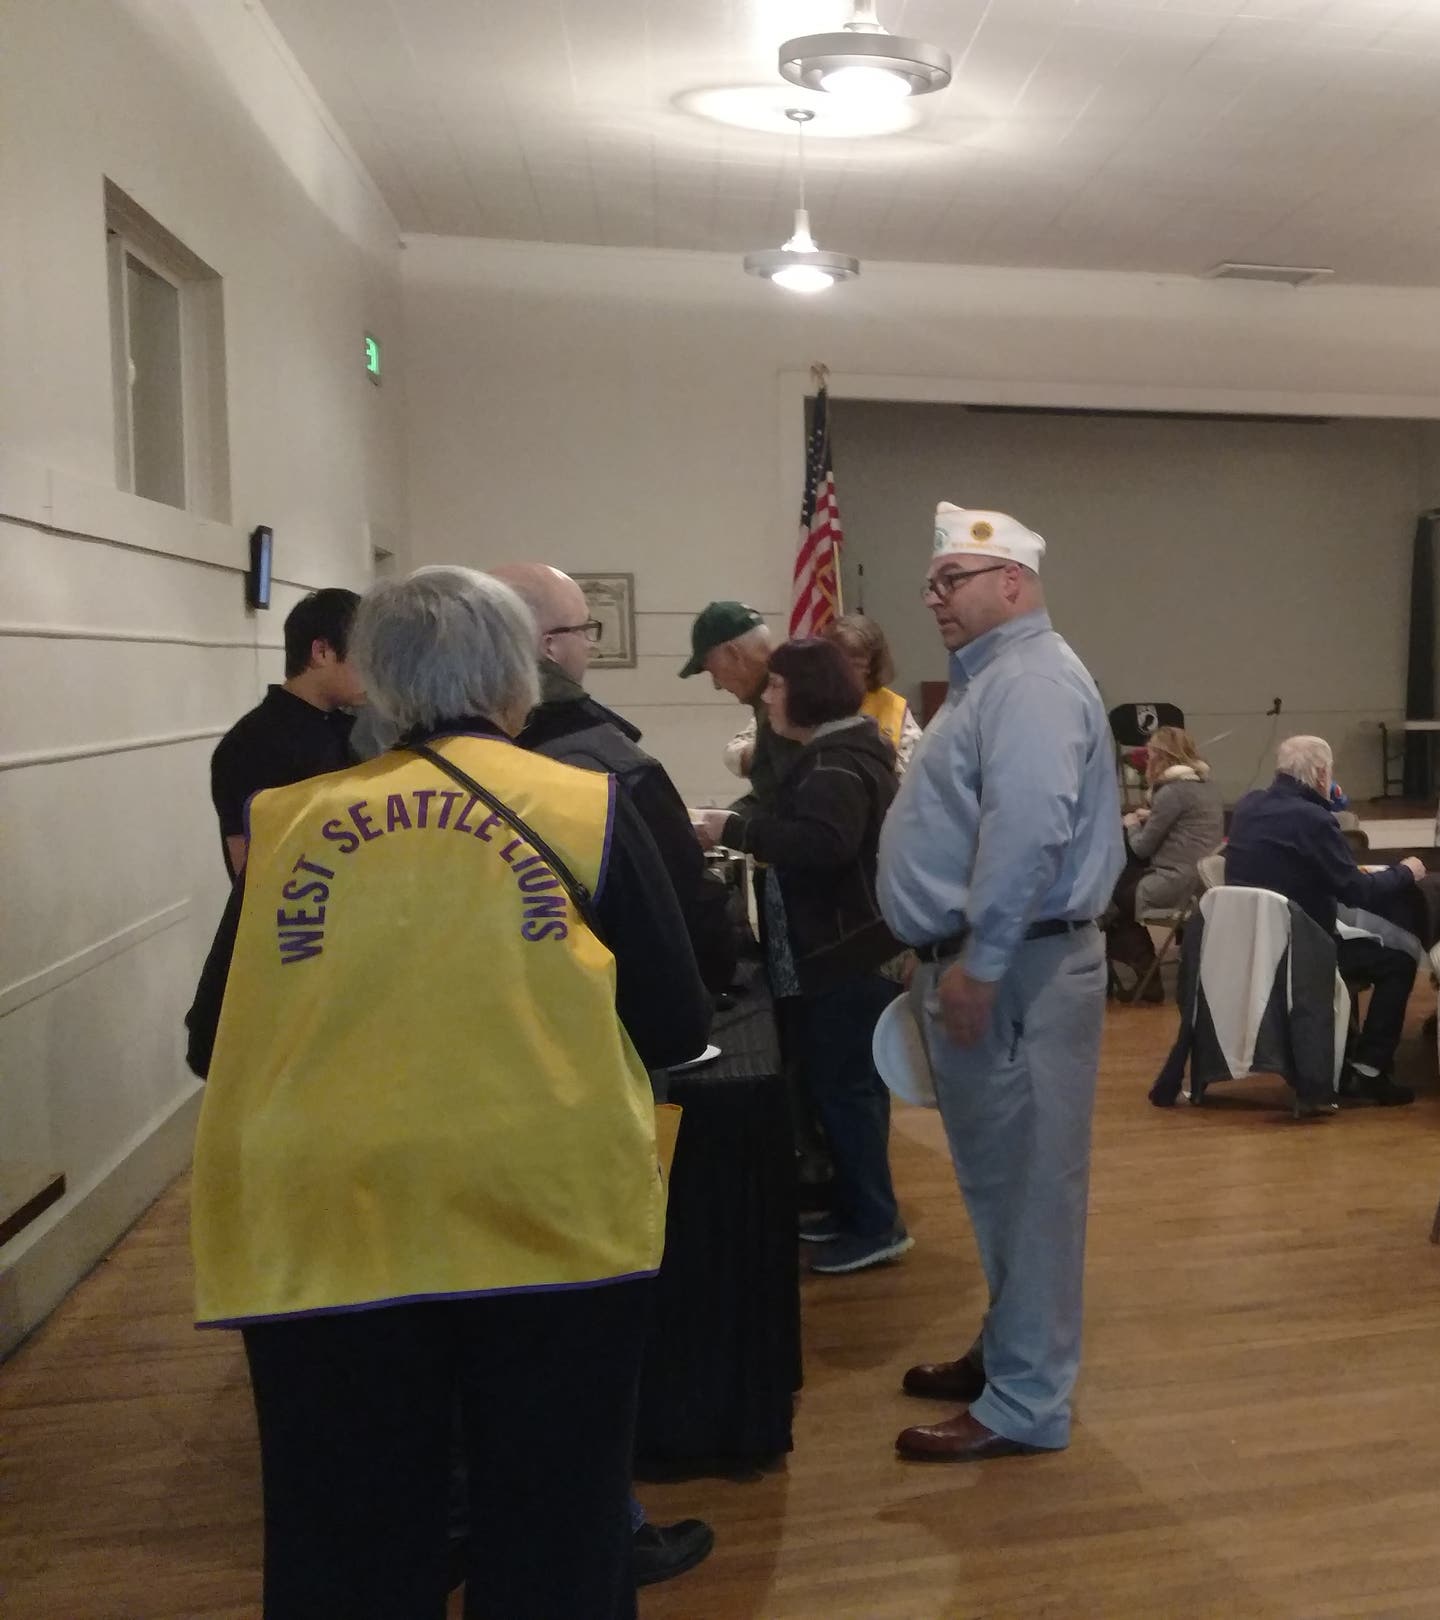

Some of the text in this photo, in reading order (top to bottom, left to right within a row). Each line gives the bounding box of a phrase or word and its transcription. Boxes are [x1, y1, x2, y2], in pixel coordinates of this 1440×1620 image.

[277, 790, 568, 965] WEST SEATTLE LIONS
